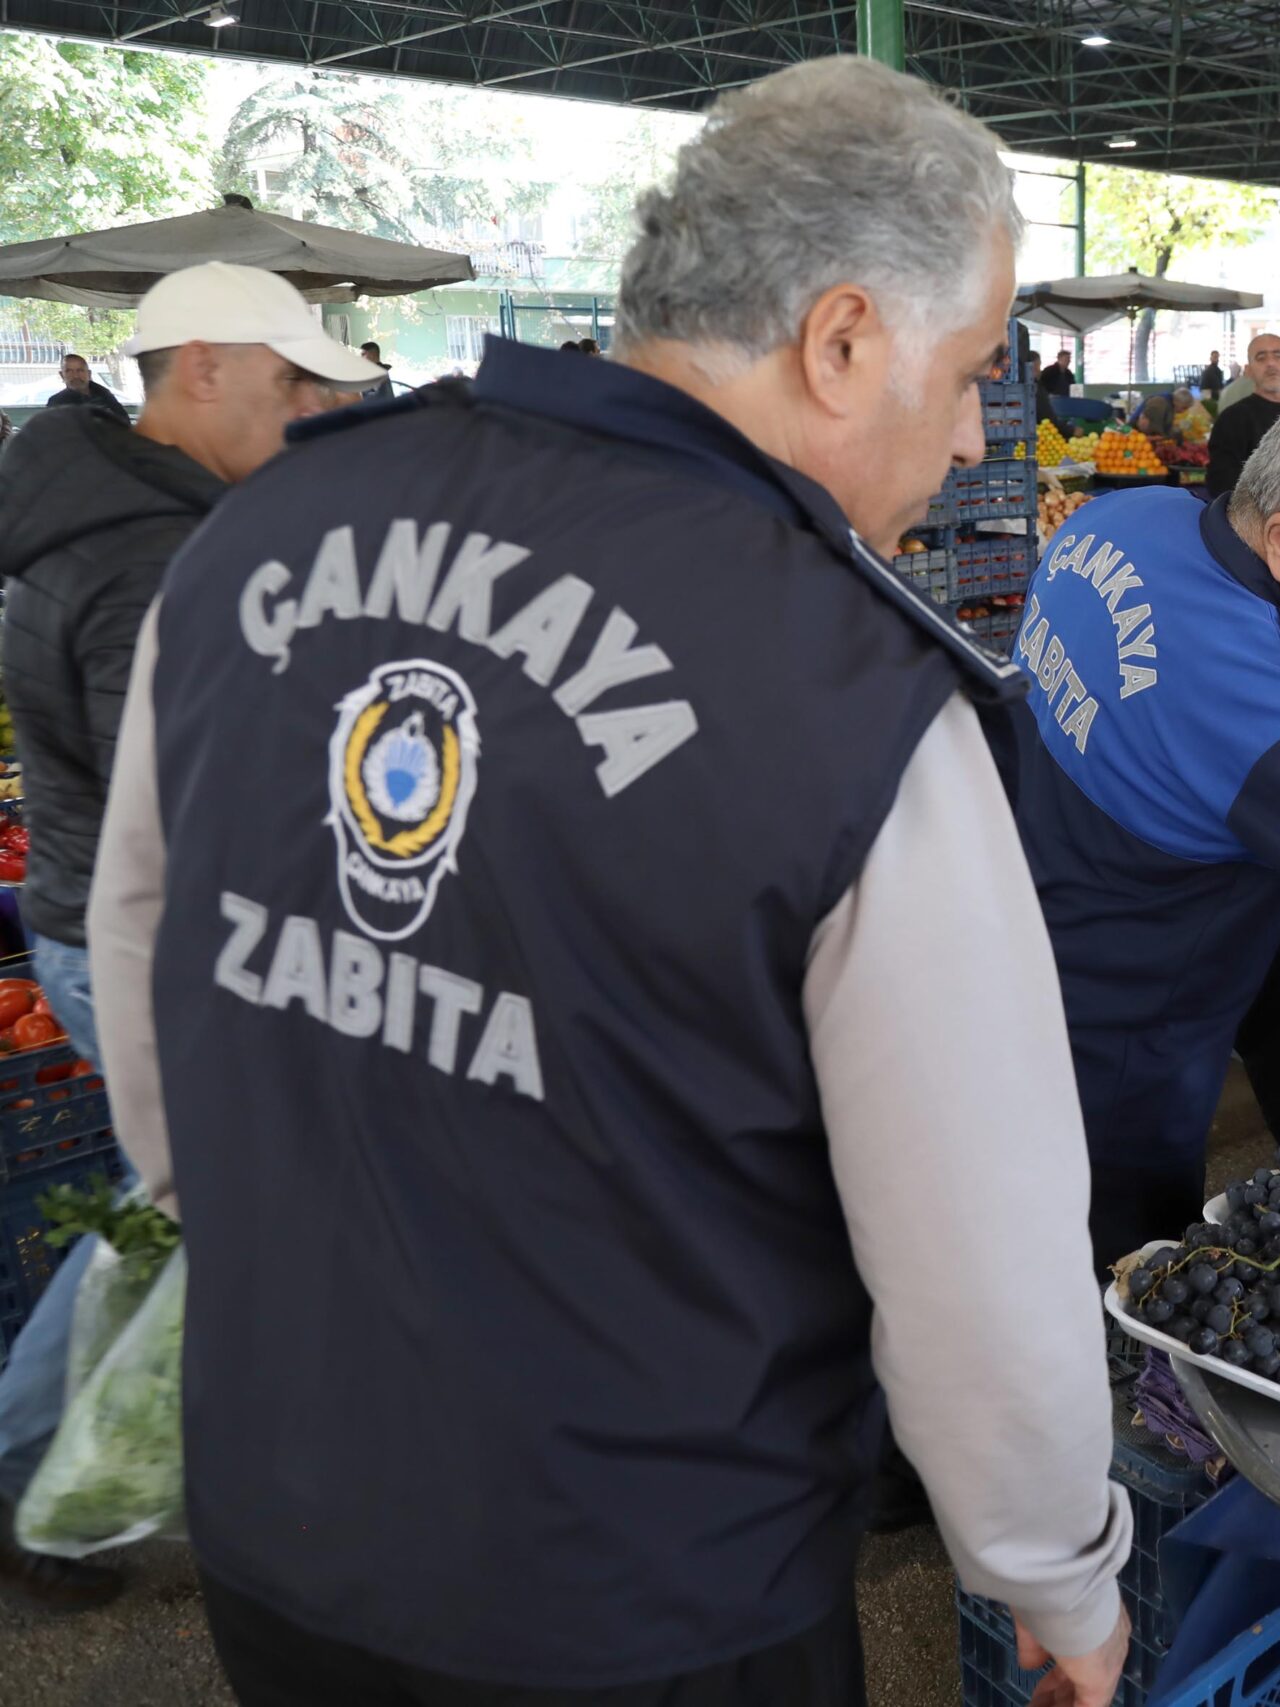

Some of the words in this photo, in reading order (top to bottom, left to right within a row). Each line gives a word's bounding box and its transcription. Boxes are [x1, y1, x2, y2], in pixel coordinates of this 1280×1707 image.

[240, 519, 699, 798] ÇANKAYA
[385, 671, 459, 720] ZABITA
[1019, 594, 1099, 756] ZABITA
[1047, 534, 1157, 699] ÇANKAYA
[215, 891, 545, 1100] ZABITA
